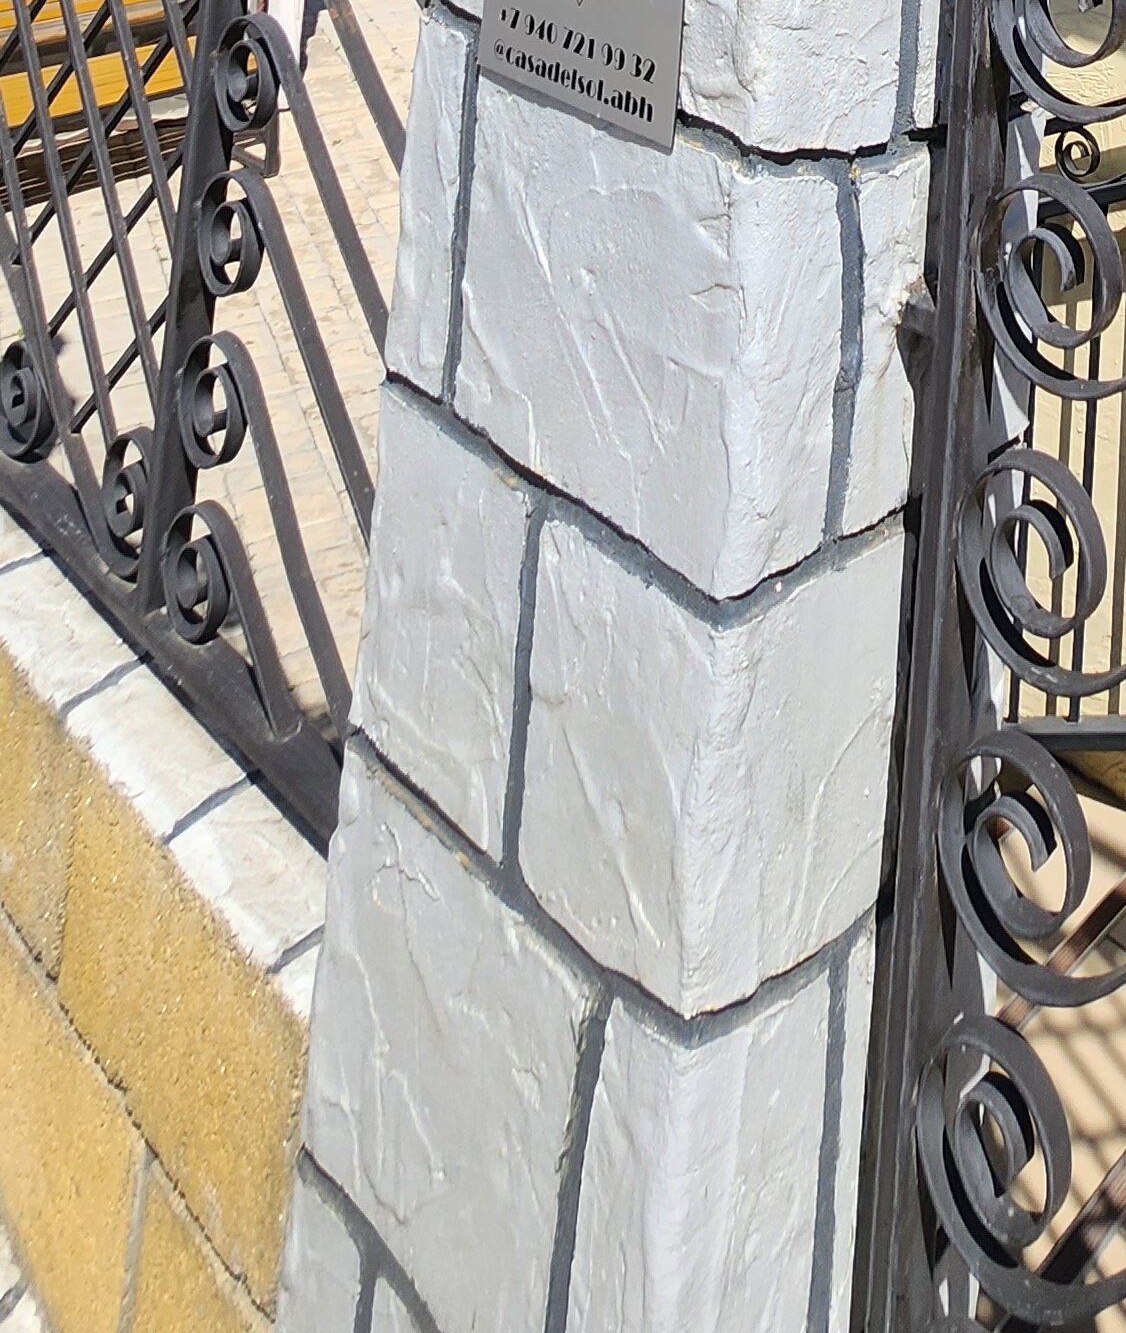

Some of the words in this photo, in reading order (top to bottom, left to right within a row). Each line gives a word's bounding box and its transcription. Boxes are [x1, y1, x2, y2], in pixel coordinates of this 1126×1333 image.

[493, 38, 654, 123] @casadelsol.abh
[499, 6, 520, 30] +7
[524, 13, 558, 45] 940
[563, 25, 596, 60] 721
[601, 42, 626, 72] 99
[629, 53, 655, 85] 32
